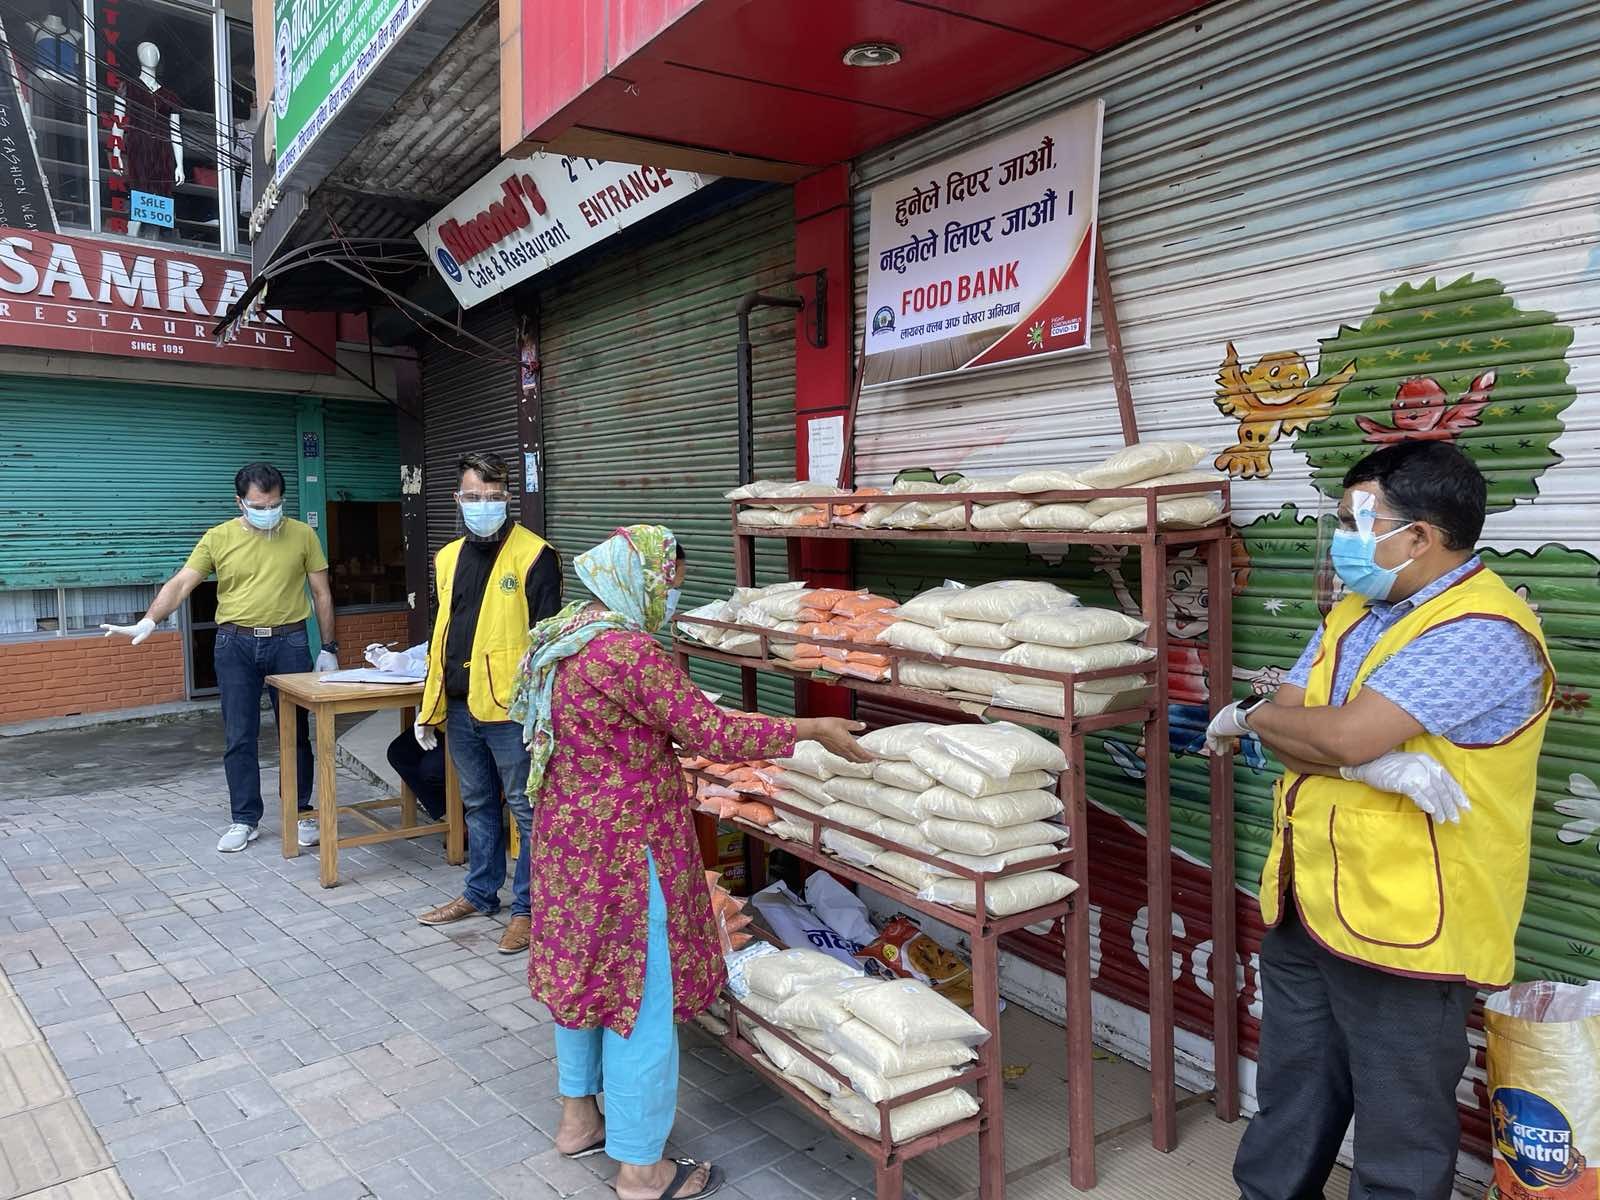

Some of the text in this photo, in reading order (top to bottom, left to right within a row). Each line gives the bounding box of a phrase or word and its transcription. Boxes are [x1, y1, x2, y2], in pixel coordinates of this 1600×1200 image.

[140, 195, 166, 209] SALE
[578, 163, 674, 228] ENTRANCE
[895, 181, 941, 226] हुनेले
[946, 166, 993, 205] दिएर
[134, 208, 172, 223] RS 500
[468, 218, 571, 288] Cafe & Restaurant
[880, 229, 939, 274] नहुनेले
[944, 217, 996, 254] लिएर
[902, 260, 1020, 316] FOOD BANK
[944, 316, 960, 330] अफ
[962, 310, 986, 325] पोखरा
[987, 302, 1021, 320] अभियान
[1052, 324, 1078, 335] COVID-19
[131, 341, 184, 354] SINCE 1995
[1513, 1122, 1571, 1144] नटराज
[1513, 1136, 1570, 1165] Natraj
